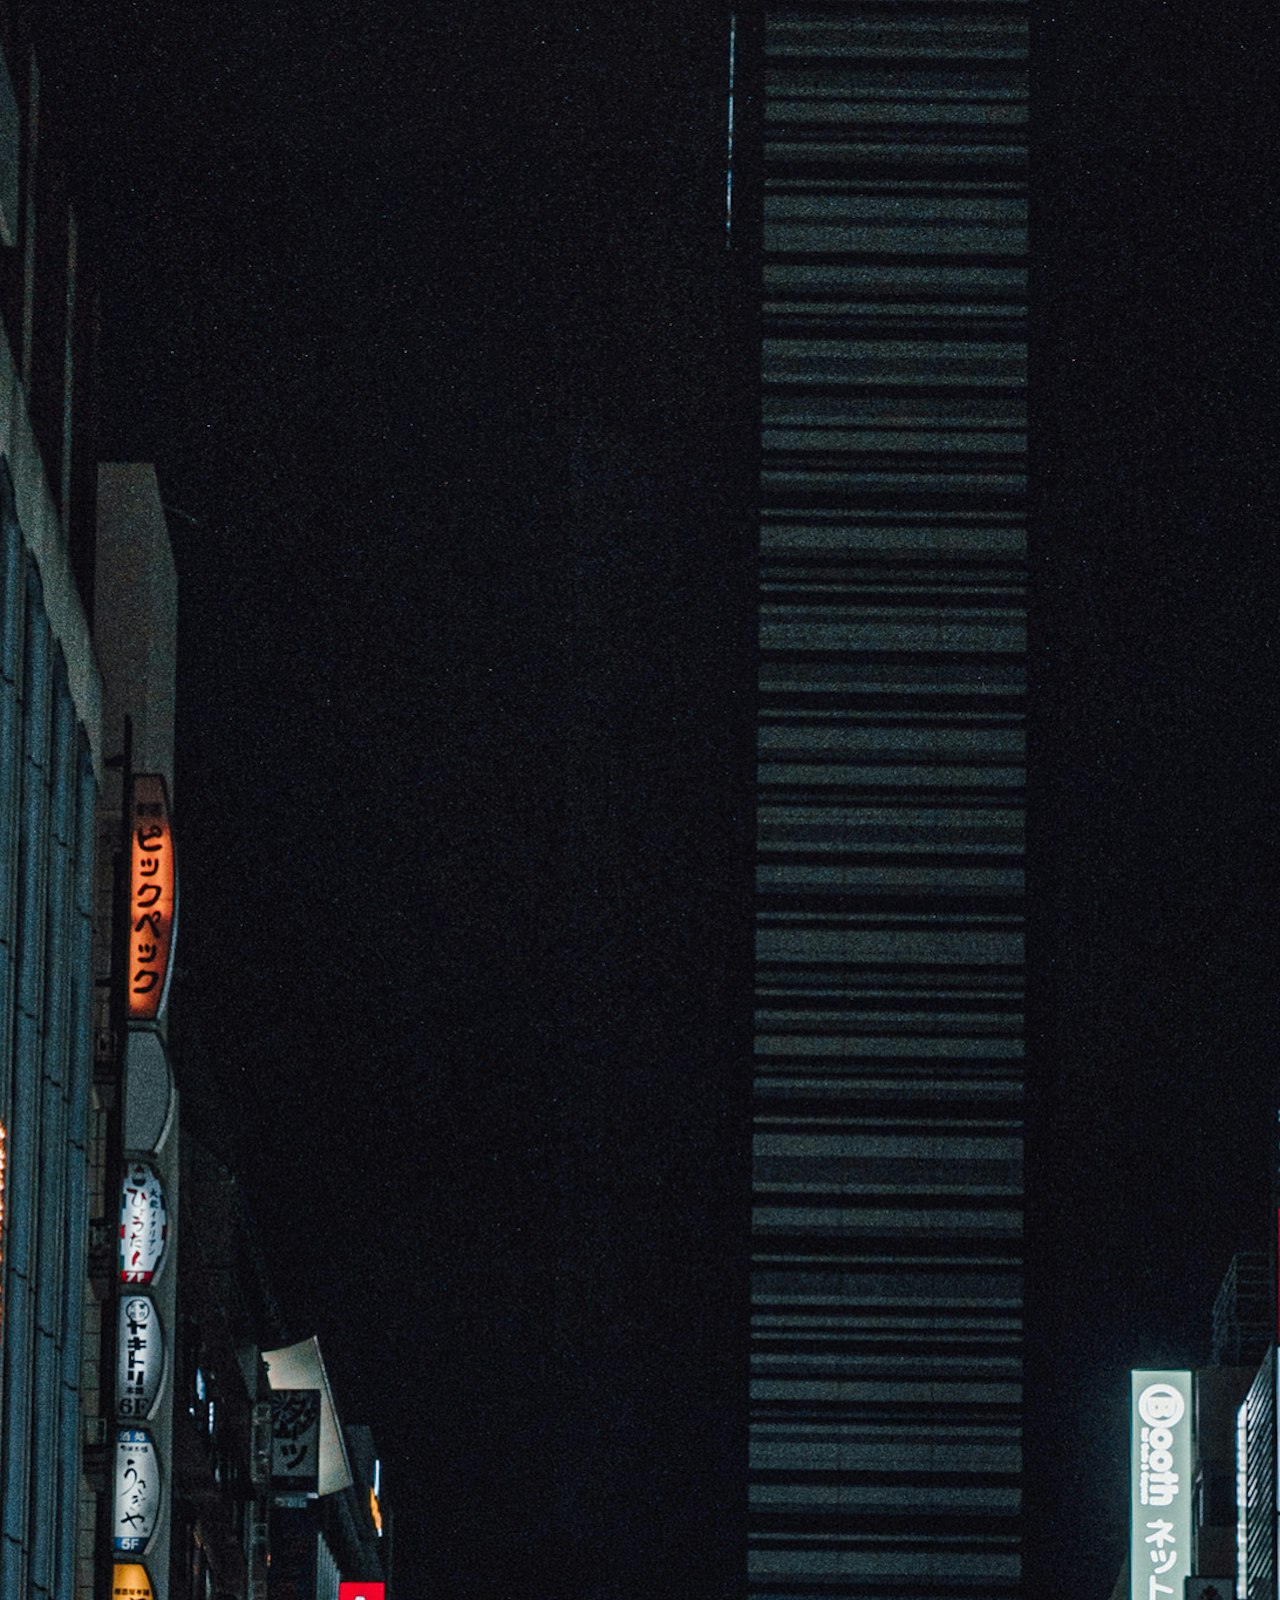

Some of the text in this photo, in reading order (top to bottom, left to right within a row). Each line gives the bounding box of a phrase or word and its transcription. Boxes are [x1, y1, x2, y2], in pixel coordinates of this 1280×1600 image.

[126, 1322, 148, 1385] ヤキトリ
[1138, 1383, 1186, 1506] Booth
[121, 1538, 141, 1551] 5F
